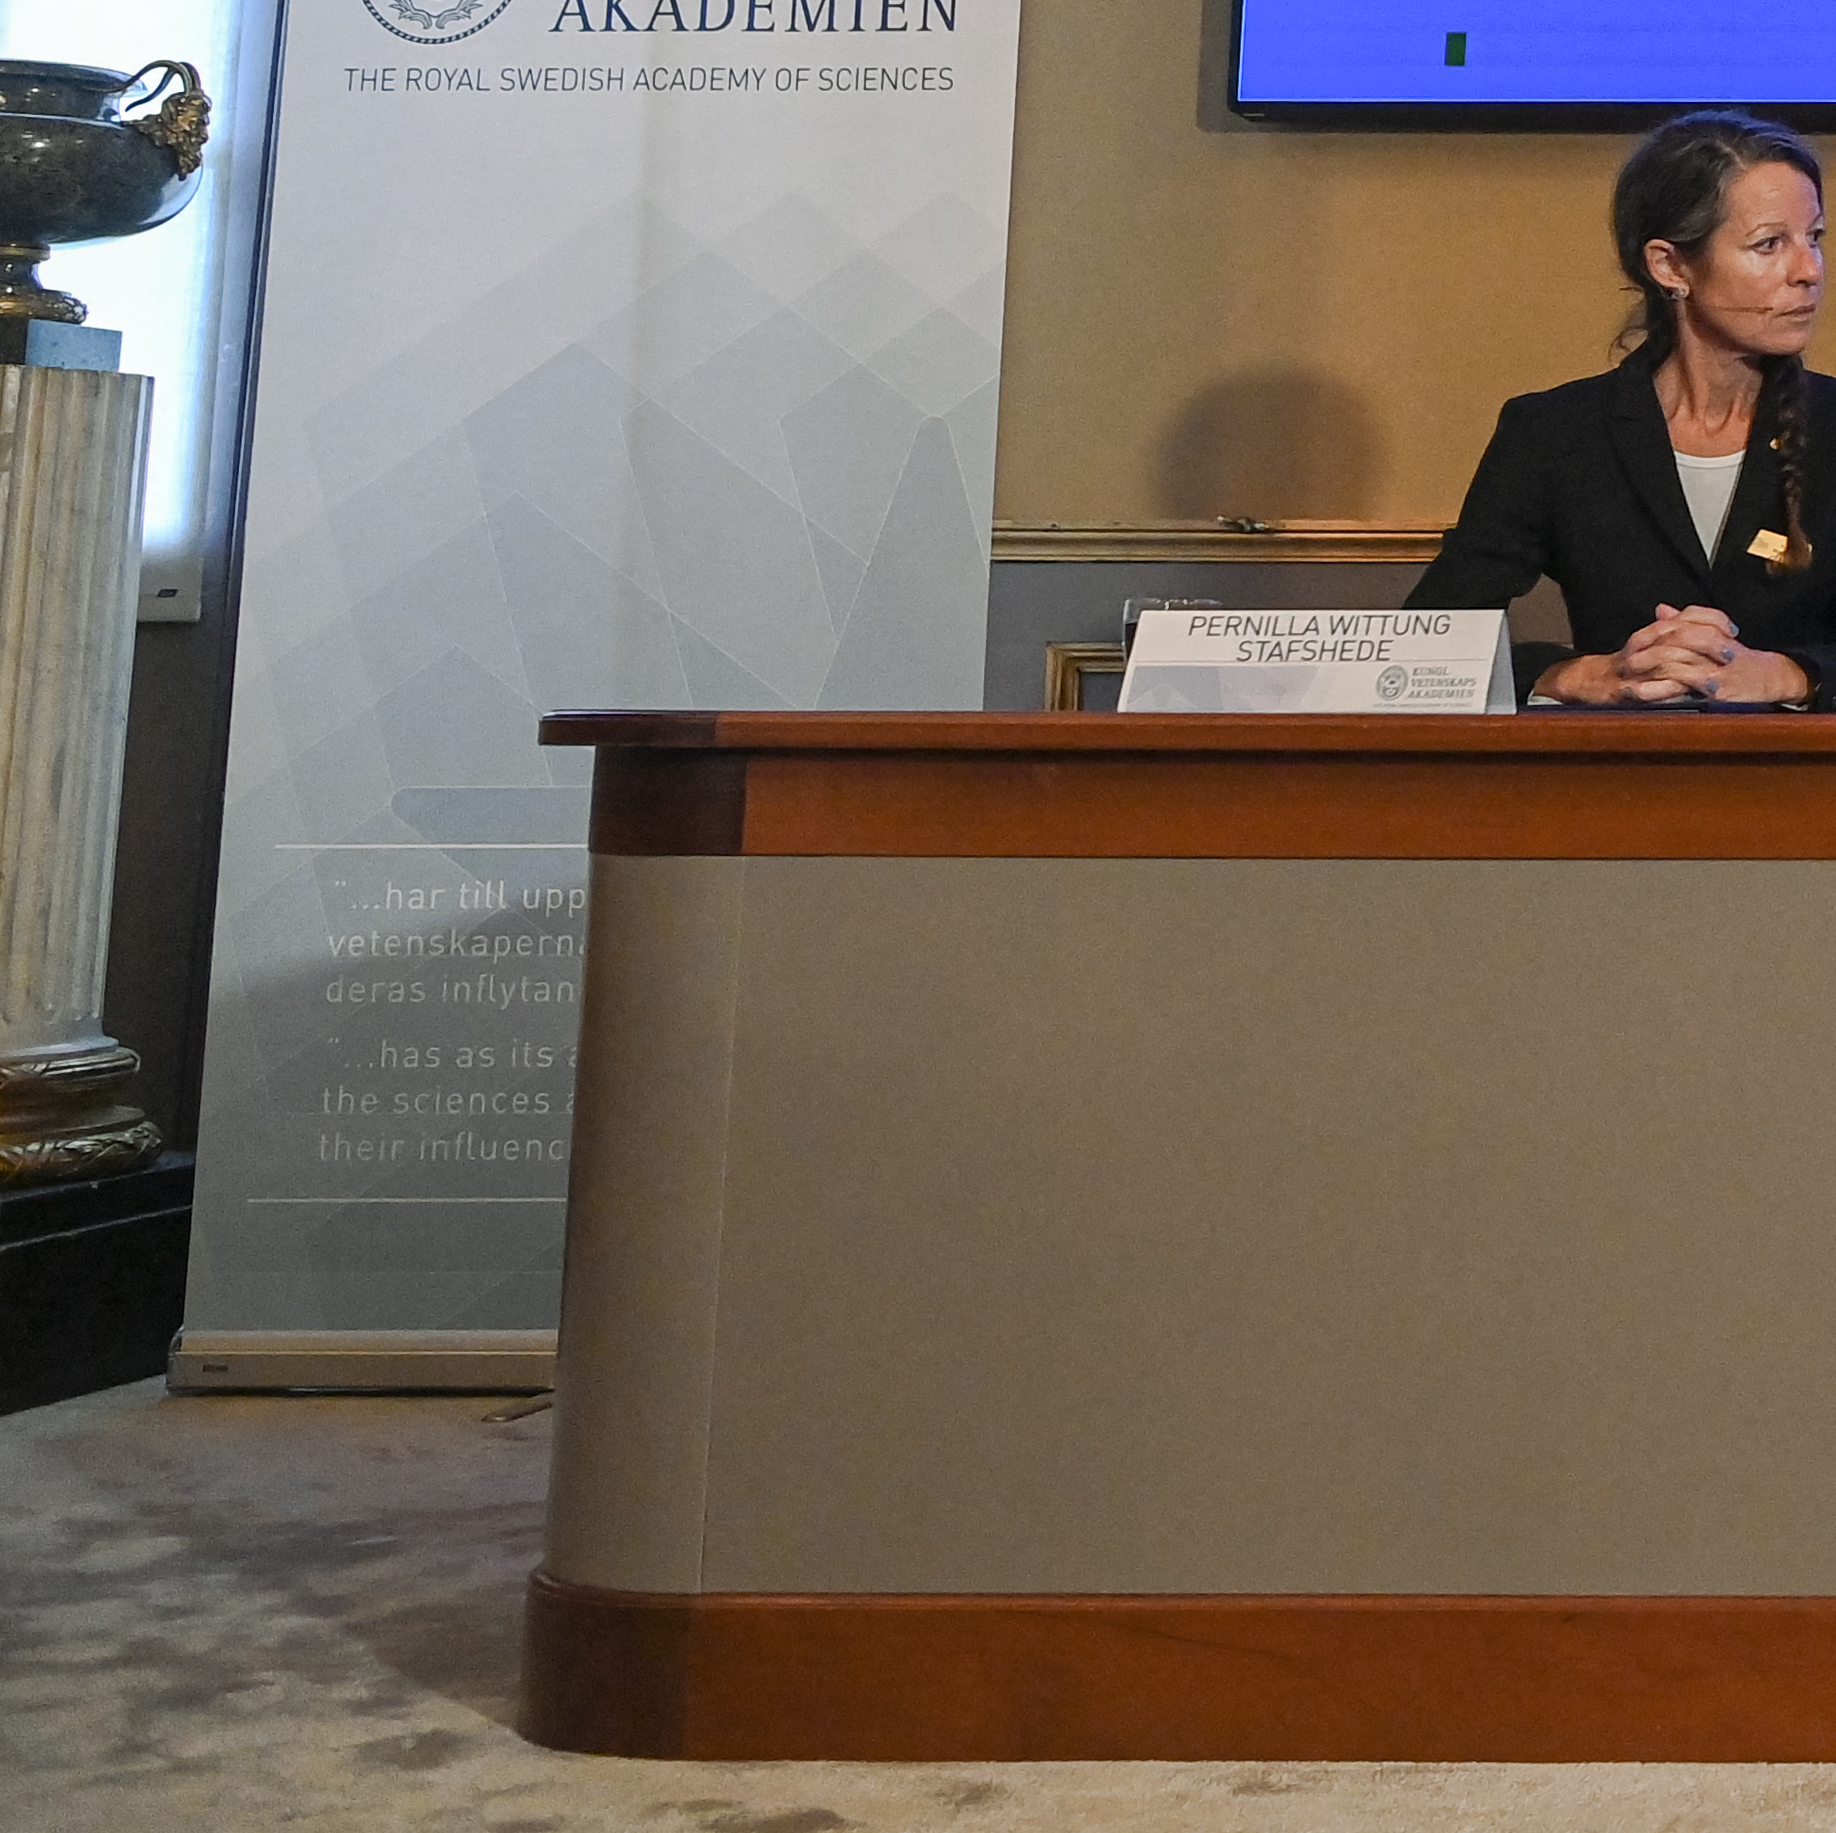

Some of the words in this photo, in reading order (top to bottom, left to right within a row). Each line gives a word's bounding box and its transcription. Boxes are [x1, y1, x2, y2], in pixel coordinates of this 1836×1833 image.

[344, 67, 397, 92] THE
[405, 67, 491, 92] ROYAL
[500, 67, 624, 92] SWEDISH
[632, 67, 767, 91] ACADEMY
[775, 67, 811, 92] OF
[818, 66, 954, 92] SCIENCES
[1188, 615, 1321, 637] PERNILLA
[1329, 614, 1452, 636] WITTUNG
[1236, 640, 1395, 662] STAFSHEDE
[458, 880, 508, 909] till
[326, 974, 426, 1004] deras
[456, 1046, 495, 1068] as
[512, 1039, 554, 1068] its
[322, 1087, 378, 1114] the
[393, 1087, 551, 1115] sciences
[318, 1132, 404, 1161] their
[419, 1131, 565, 1161] influenc
